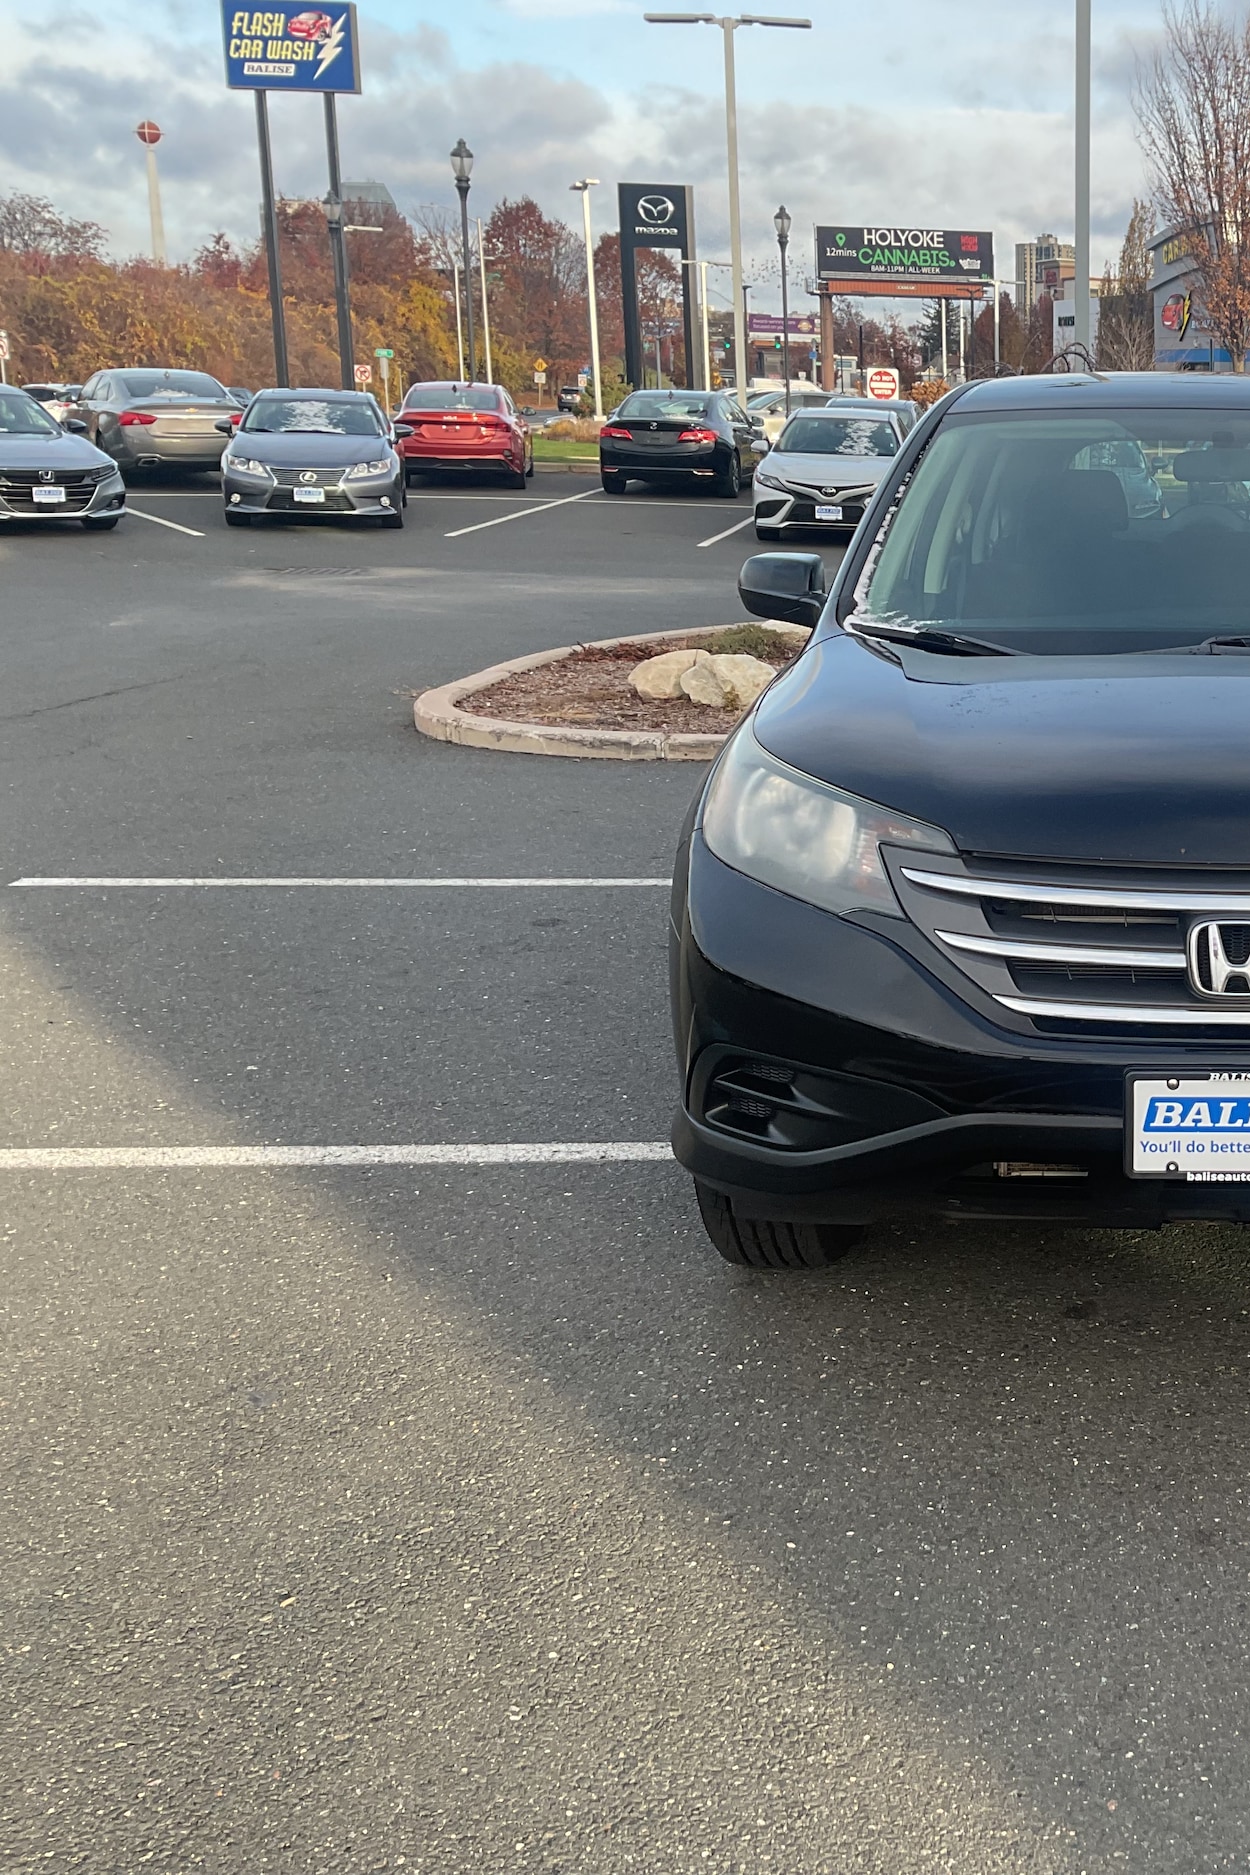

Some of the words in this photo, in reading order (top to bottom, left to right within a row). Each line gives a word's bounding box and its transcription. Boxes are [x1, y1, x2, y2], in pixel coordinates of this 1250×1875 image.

[232, 11, 285, 37] FLASH
[229, 38, 263, 59] CAR
[266, 40, 315, 61] WASH
[246, 64, 293, 74] BALISE
[635, 226, 678, 235] mazda
[863, 228, 944, 248] HOLYOKE
[826, 247, 857, 257] 12mins
[1140, 1141, 1181, 1153] You'll
[1186, 1141, 1205, 1153] do
